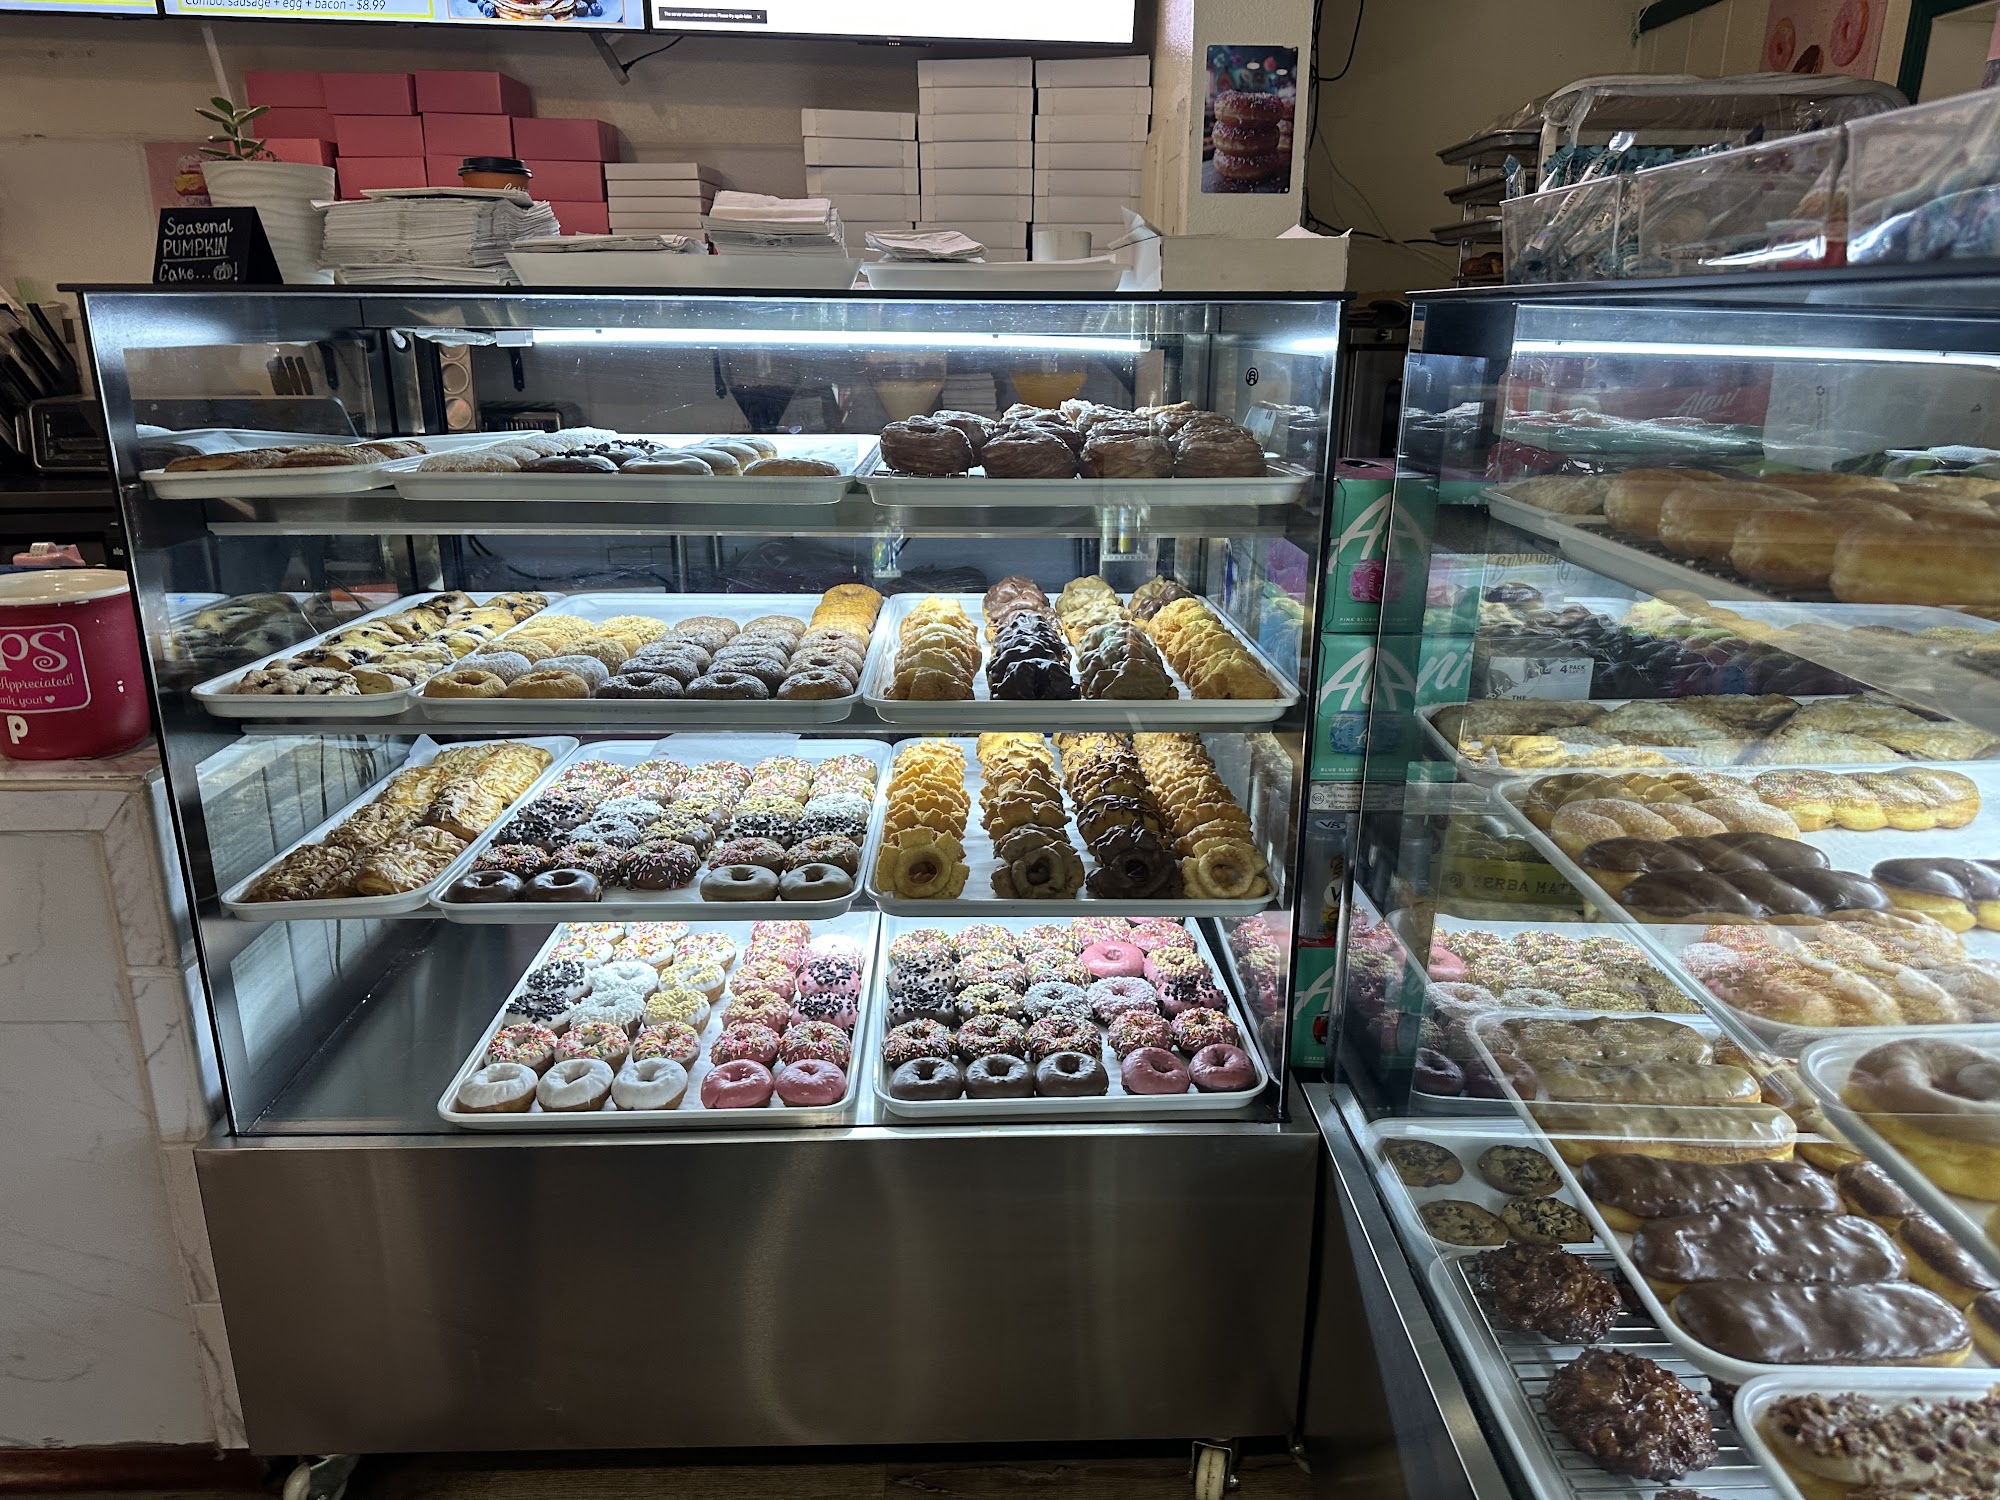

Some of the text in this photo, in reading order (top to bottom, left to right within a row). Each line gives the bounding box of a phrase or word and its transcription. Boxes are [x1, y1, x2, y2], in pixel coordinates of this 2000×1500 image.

[227, 0, 270, 10] sausage
[283, 0, 302, 11] egg
[315, 0, 346, 9] bacon
[356, 0, 387, 11] $8.99
[165, 217, 233, 236] Seasonal
[163, 236, 228, 257] PUMPKIN
[1559, 664, 1568, 674] 4
[19, 696, 43, 708] you!
